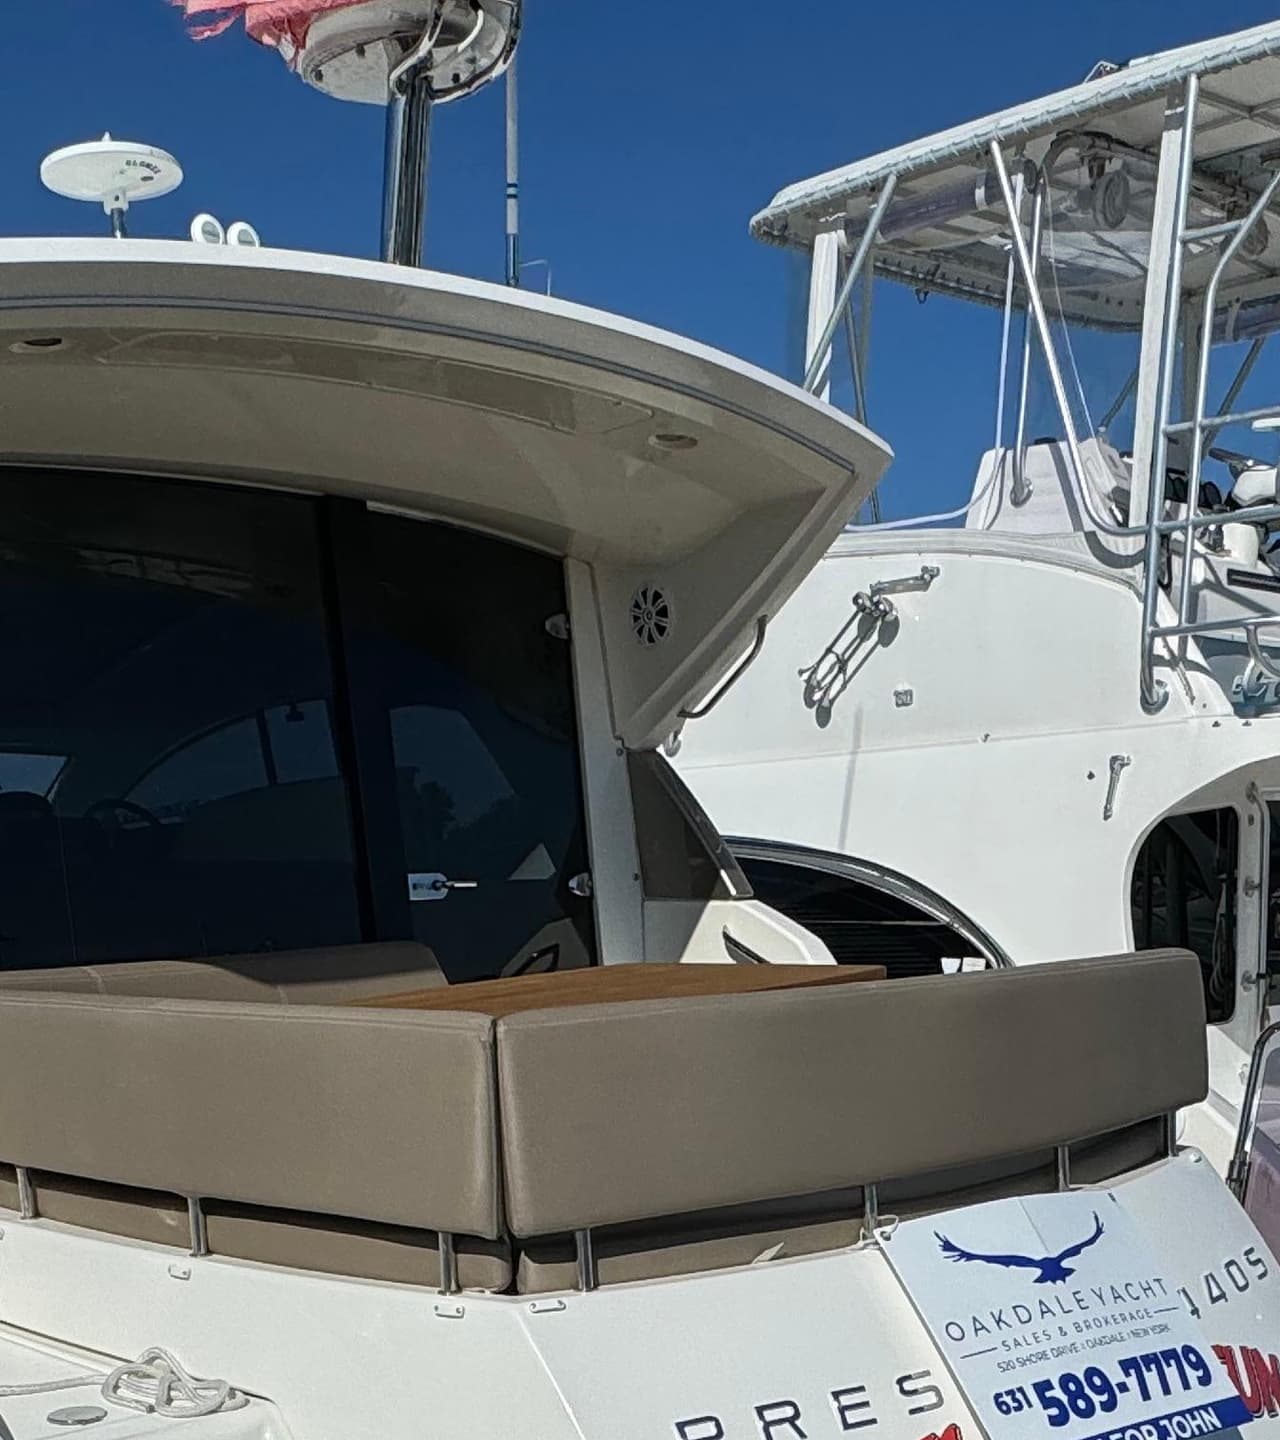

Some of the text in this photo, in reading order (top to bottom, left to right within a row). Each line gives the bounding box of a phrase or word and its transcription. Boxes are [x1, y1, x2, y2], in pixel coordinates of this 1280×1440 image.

[1001, 1307, 1153, 1352] SALES & BROKERAGE
[997, 1361, 1017, 1373] 520
[1016, 1351, 1051, 1368] SHORE
[1050, 1343, 1081, 1360] DRIVE
[993, 1344, 1212, 1428] 631 589-7779
